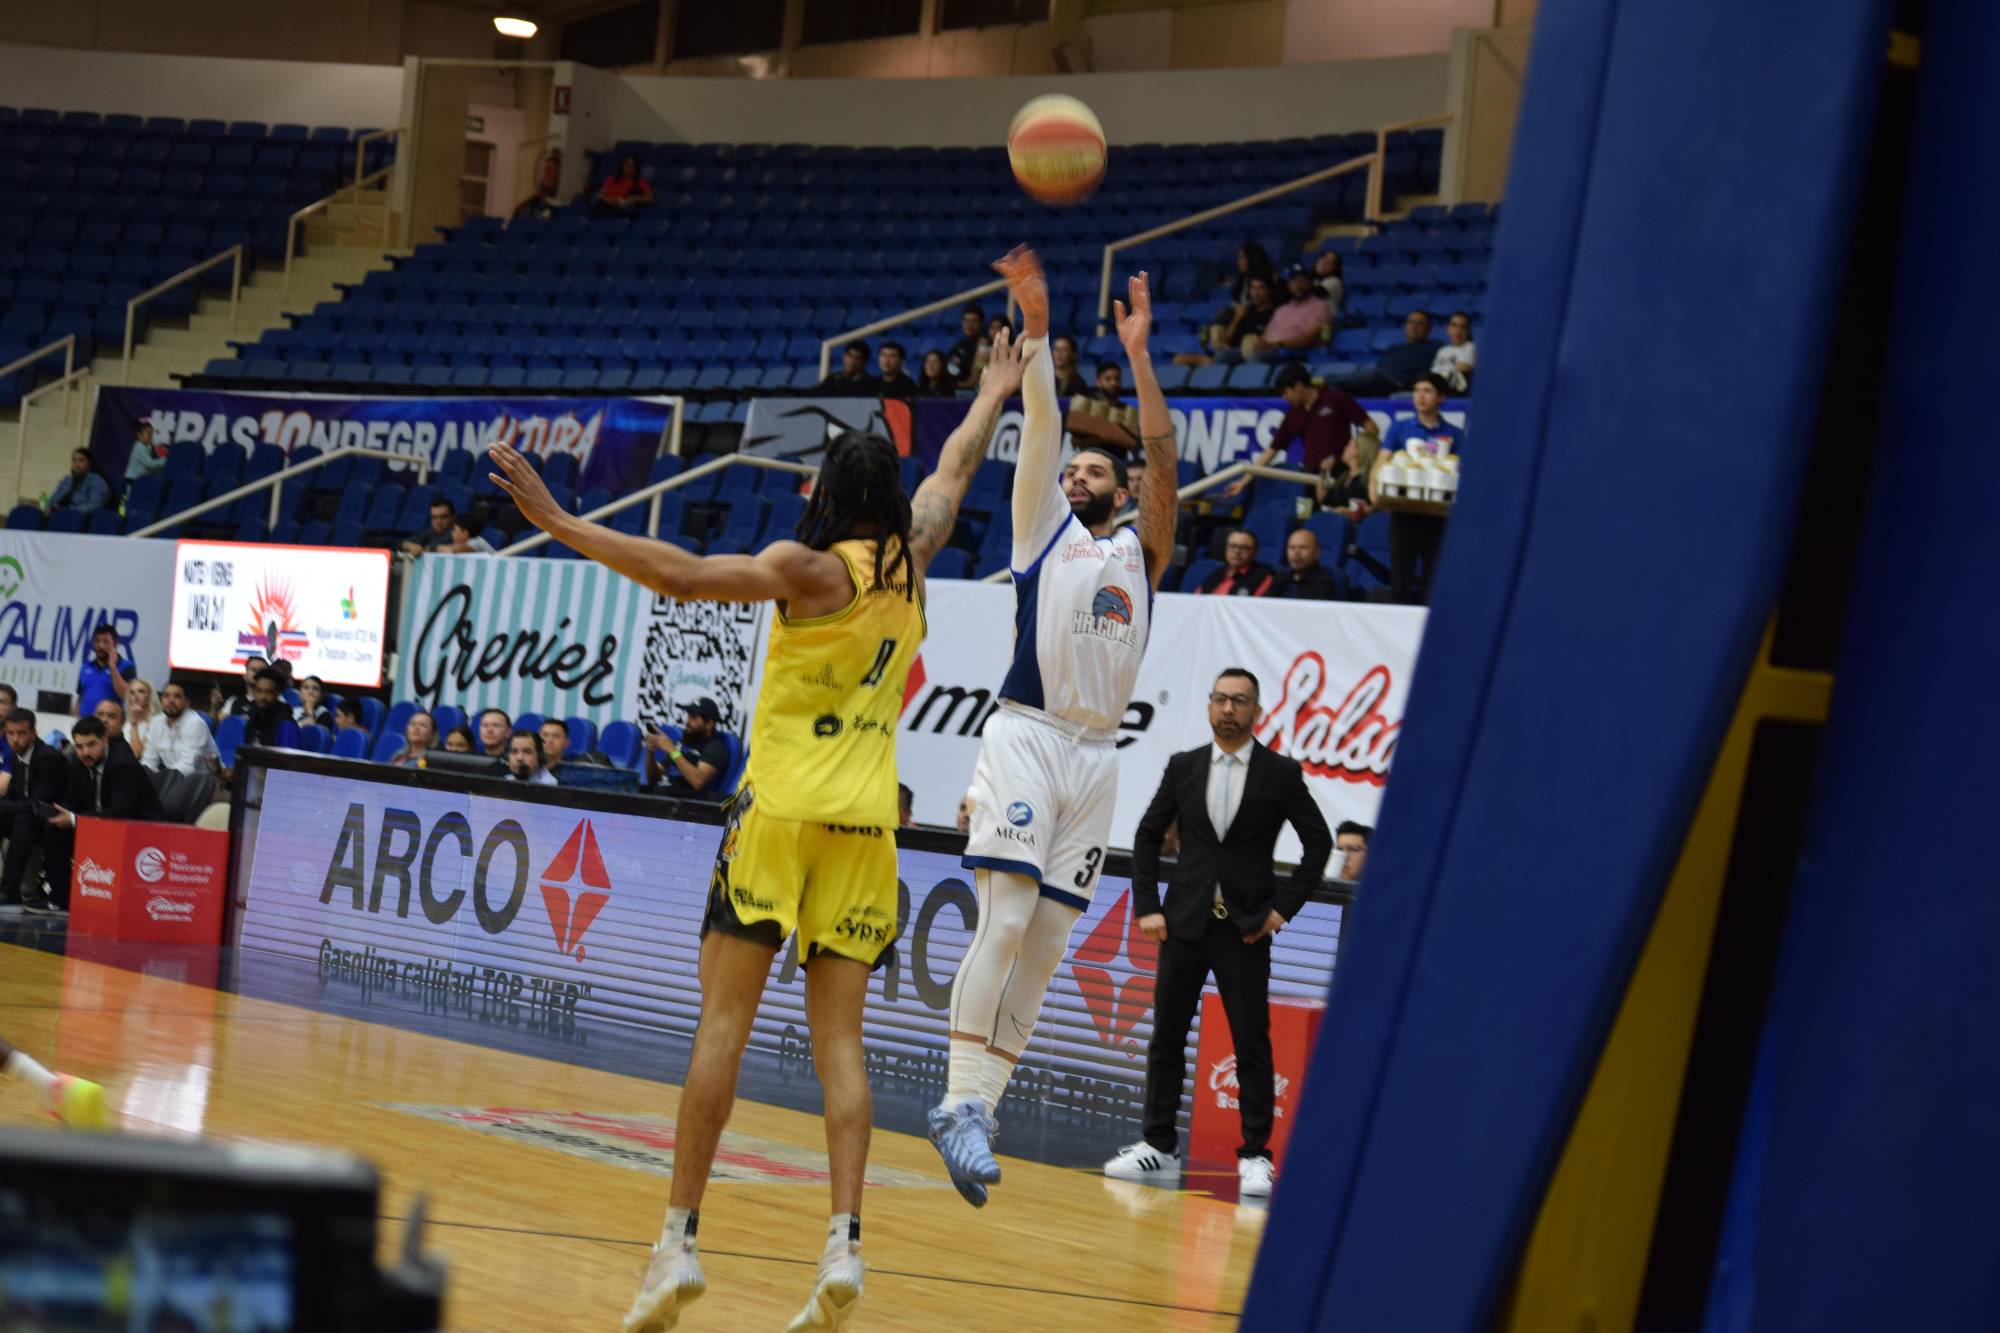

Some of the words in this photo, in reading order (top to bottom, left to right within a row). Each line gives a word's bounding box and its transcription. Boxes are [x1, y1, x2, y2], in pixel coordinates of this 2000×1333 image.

[413, 583, 617, 708] Grenier
[994, 826, 1036, 847] MEGA
[319, 803, 530, 935] ARCO
[1073, 846, 1102, 888] 3
[319, 938, 398, 978] Gasolina
[403, 957, 475, 997] calidad
